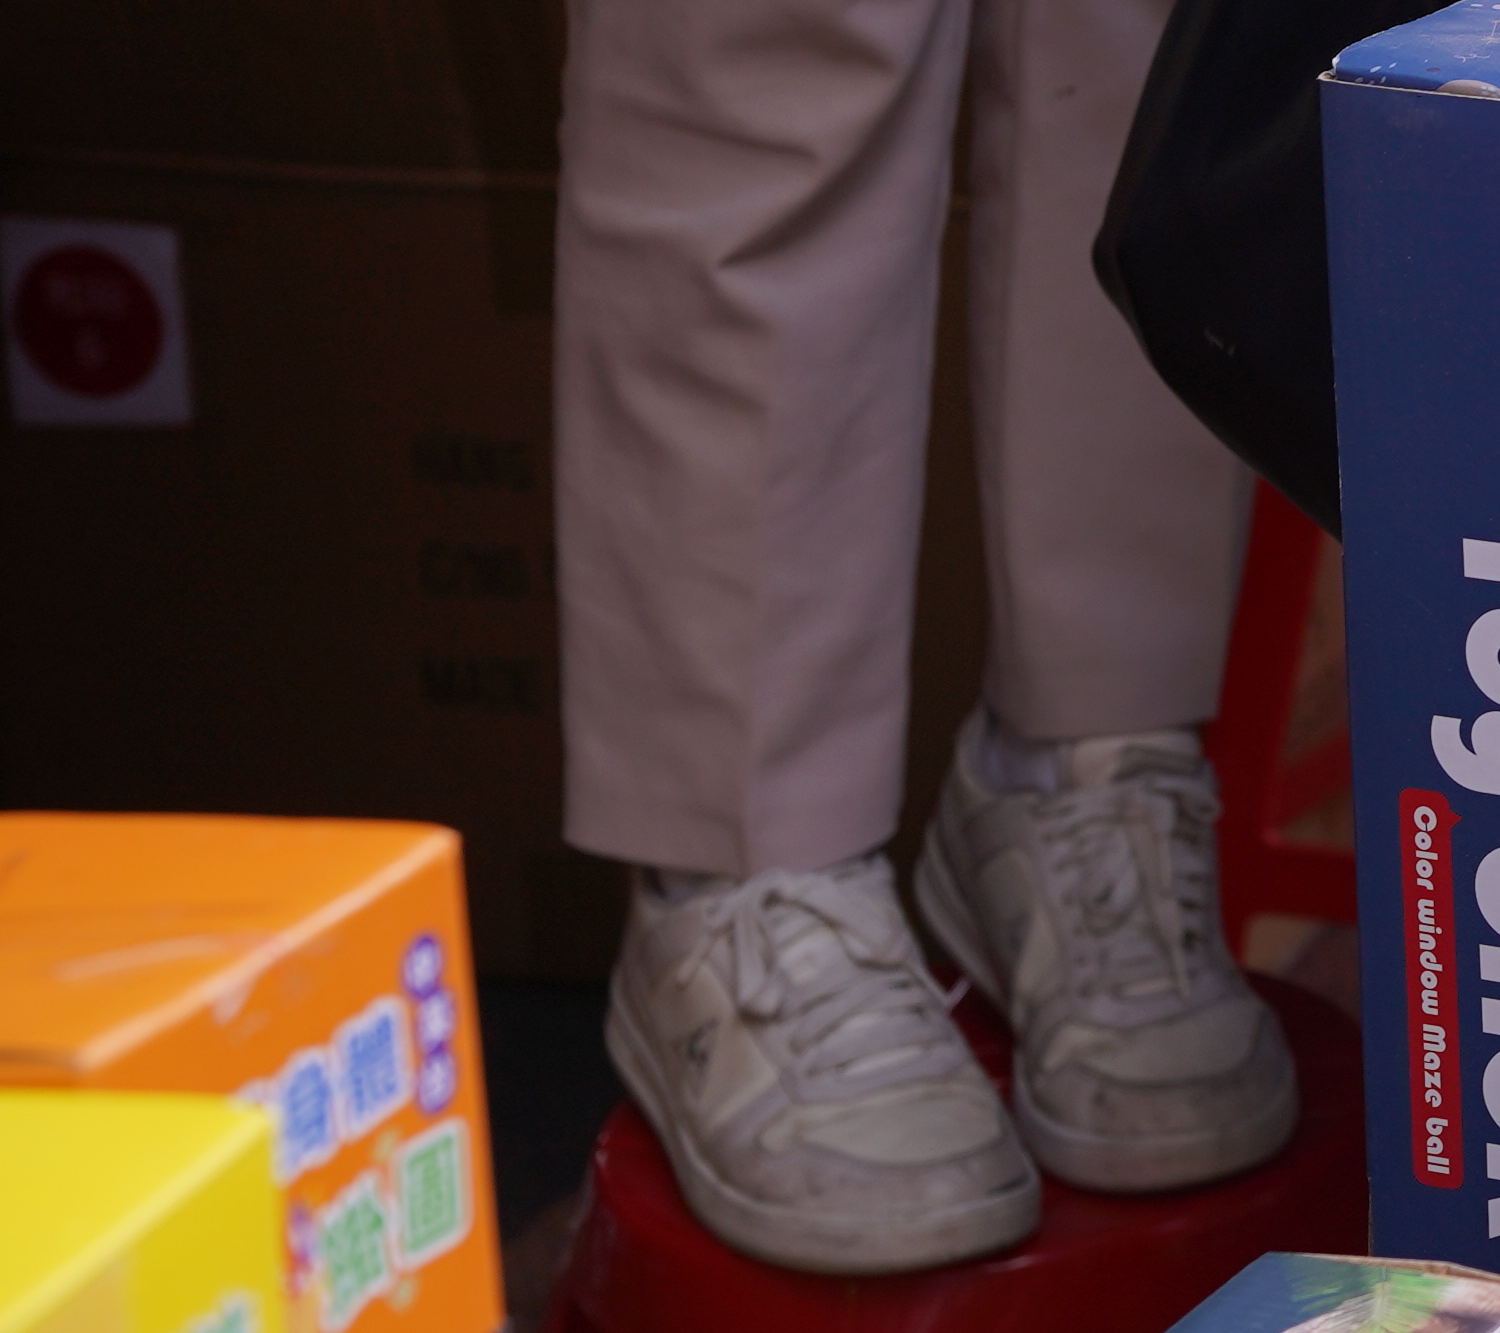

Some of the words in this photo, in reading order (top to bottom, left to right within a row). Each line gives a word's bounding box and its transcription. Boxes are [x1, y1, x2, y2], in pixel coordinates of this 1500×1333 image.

[1413, 805, 1439, 891] Color
[1416, 896, 1440, 1012] window
[1422, 1016, 1448, 1110] Maze
[1426, 1114, 1451, 1176] ball
